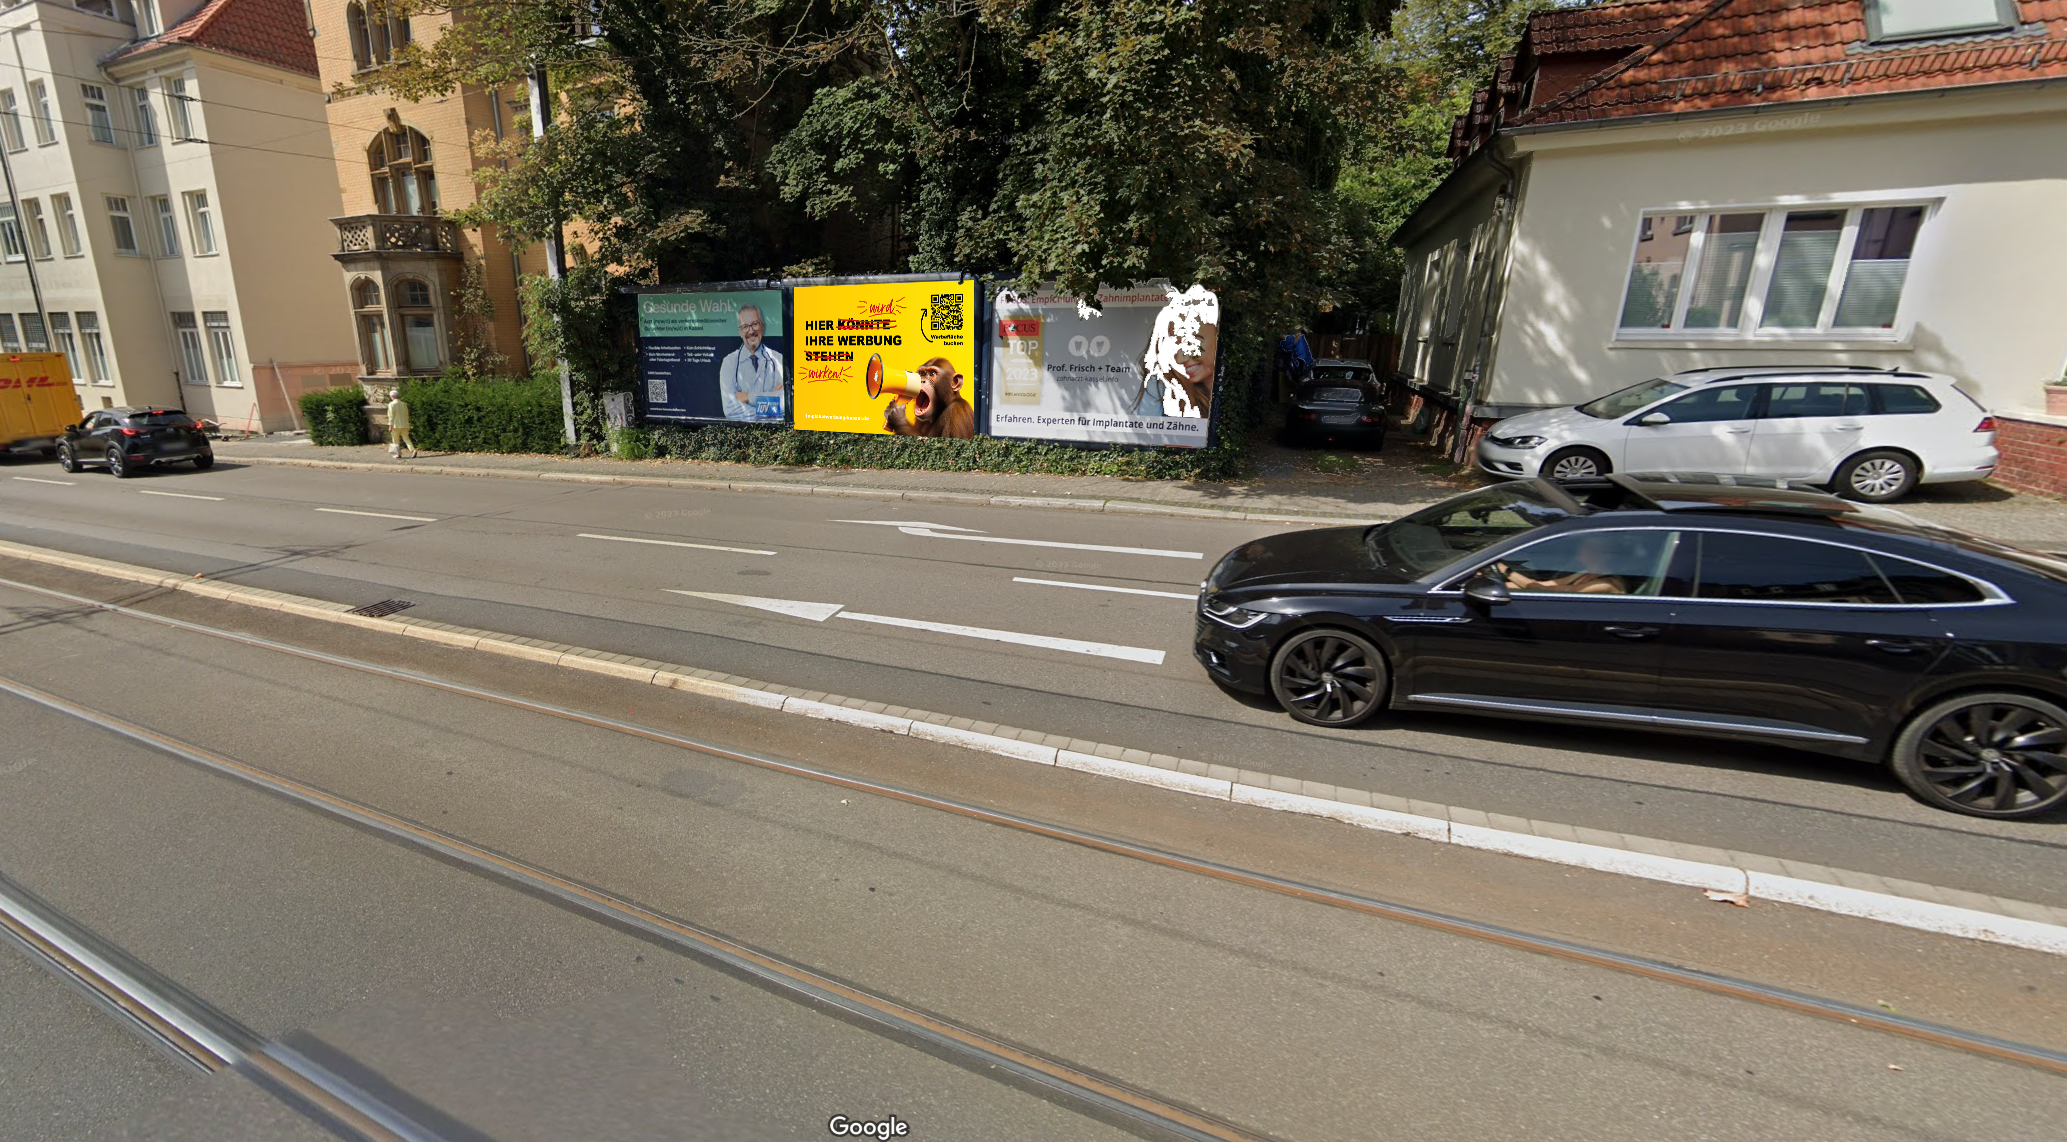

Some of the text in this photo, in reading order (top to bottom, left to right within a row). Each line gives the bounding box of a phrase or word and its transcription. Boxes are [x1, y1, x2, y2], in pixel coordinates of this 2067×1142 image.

[643, 300, 697, 314] Gesunde
[805, 318, 892, 331] HIER KÖNNTE
[805, 335, 902, 346] IHRE WERBUNG
[1007, 340, 1039, 356] TOP
[805, 351, 854, 362] STEHEN
[1006, 368, 1038, 381] 2023
[1046, 363, 1067, 372] Prof.
[1069, 363, 1096, 372] Frisch
[1105, 364, 1131, 373] Team
[996, 414, 1200, 432] Erfahren. Experten für Implantate und Zähne.
